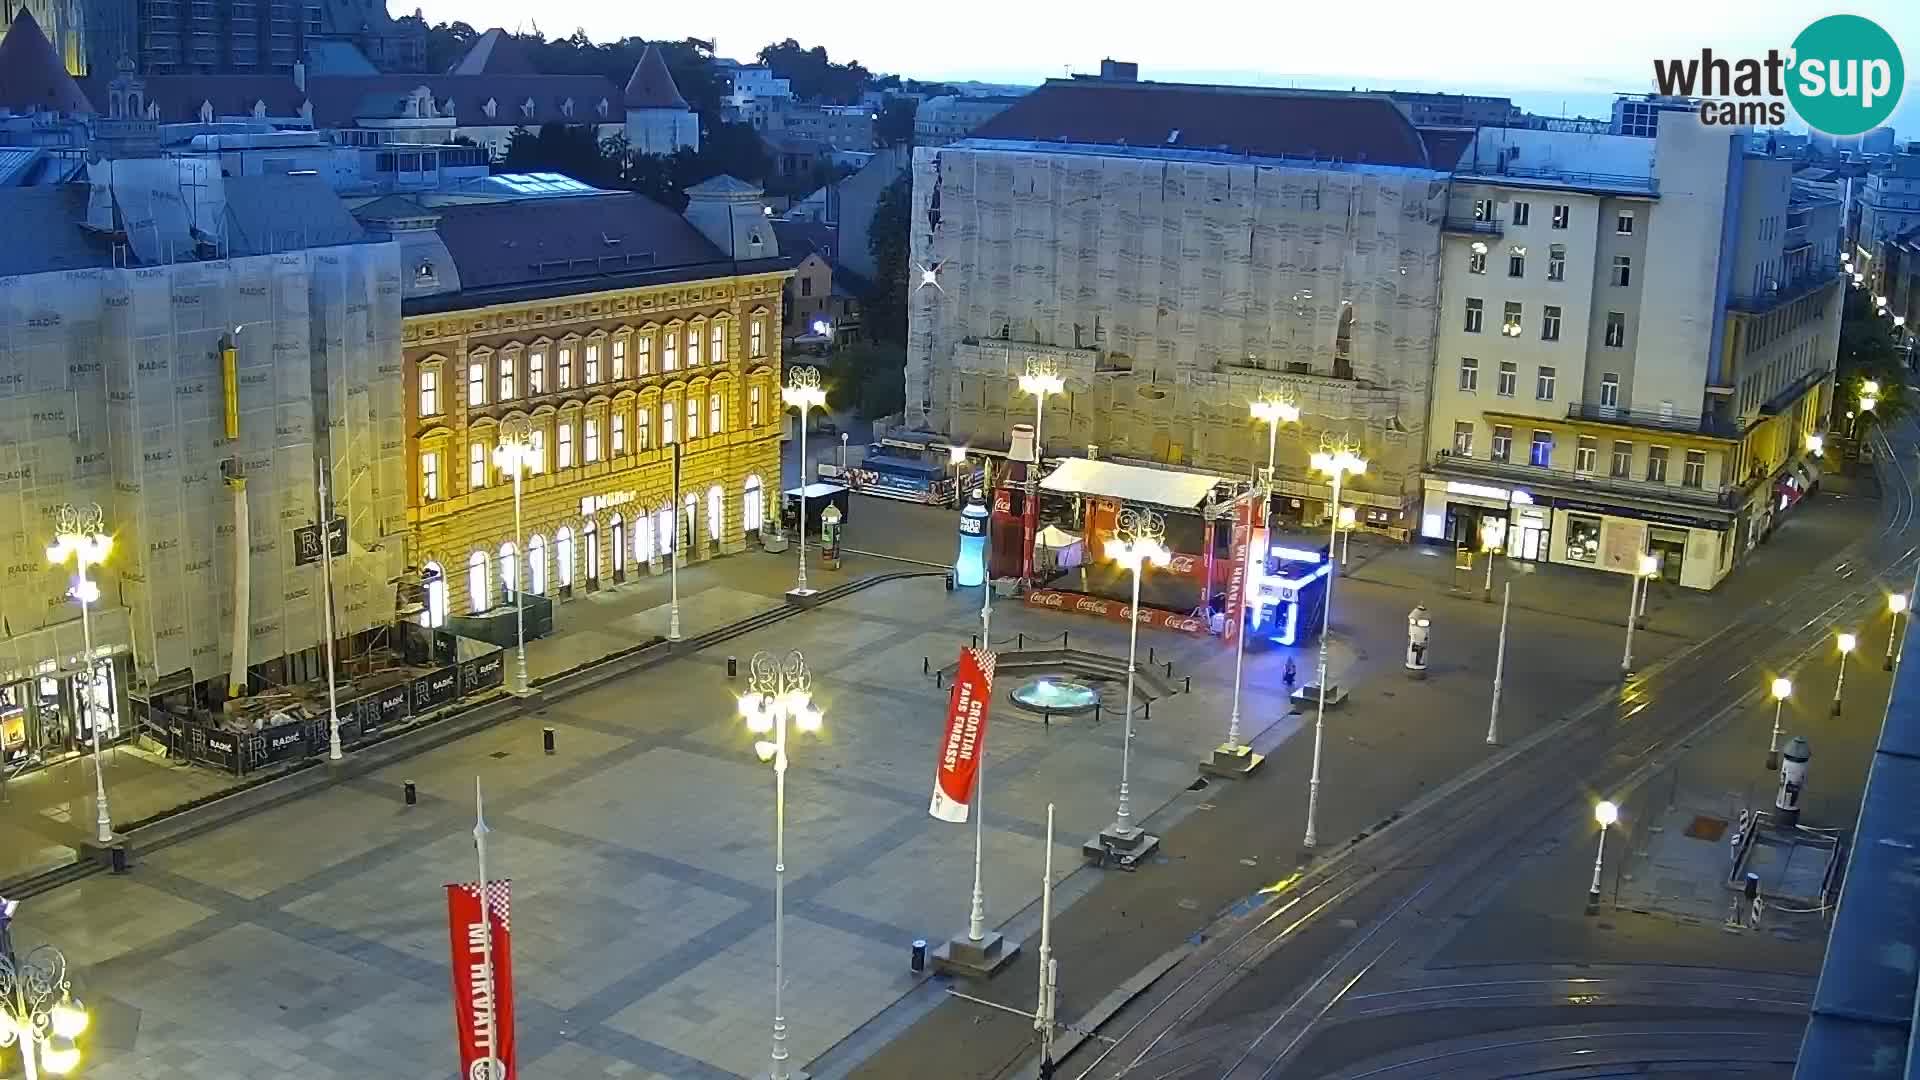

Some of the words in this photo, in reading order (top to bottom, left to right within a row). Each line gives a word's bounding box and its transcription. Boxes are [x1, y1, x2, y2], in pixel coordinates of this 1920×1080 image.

[957, 682, 972, 712] FANS
[944, 716, 965, 773] EMBASSY
[960, 699, 982, 760] CROATIAN
